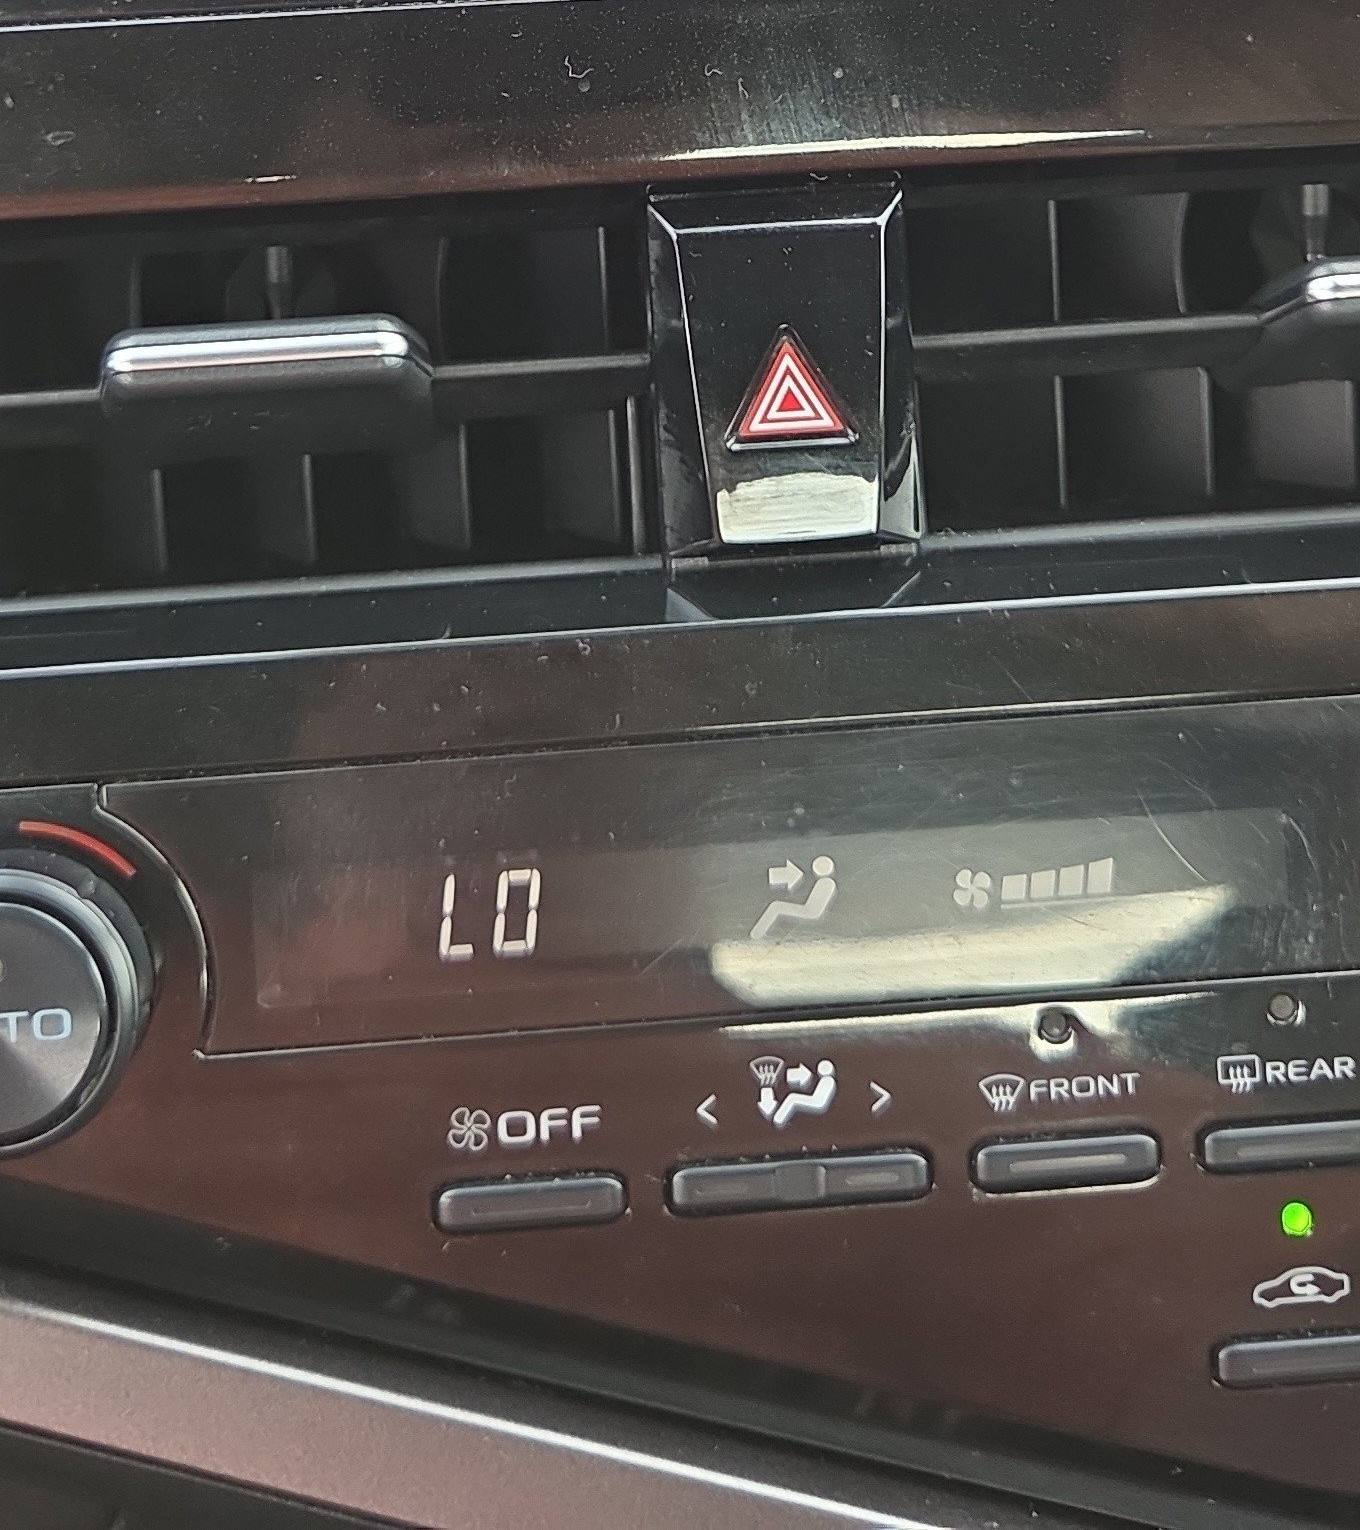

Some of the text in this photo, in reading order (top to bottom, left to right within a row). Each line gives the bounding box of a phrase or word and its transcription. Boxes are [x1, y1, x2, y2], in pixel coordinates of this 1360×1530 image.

[1266, 1056, 1356, 1083] REAR
[1029, 1072, 1140, 1101] FRONT
[497, 1105, 601, 1145] OFF
